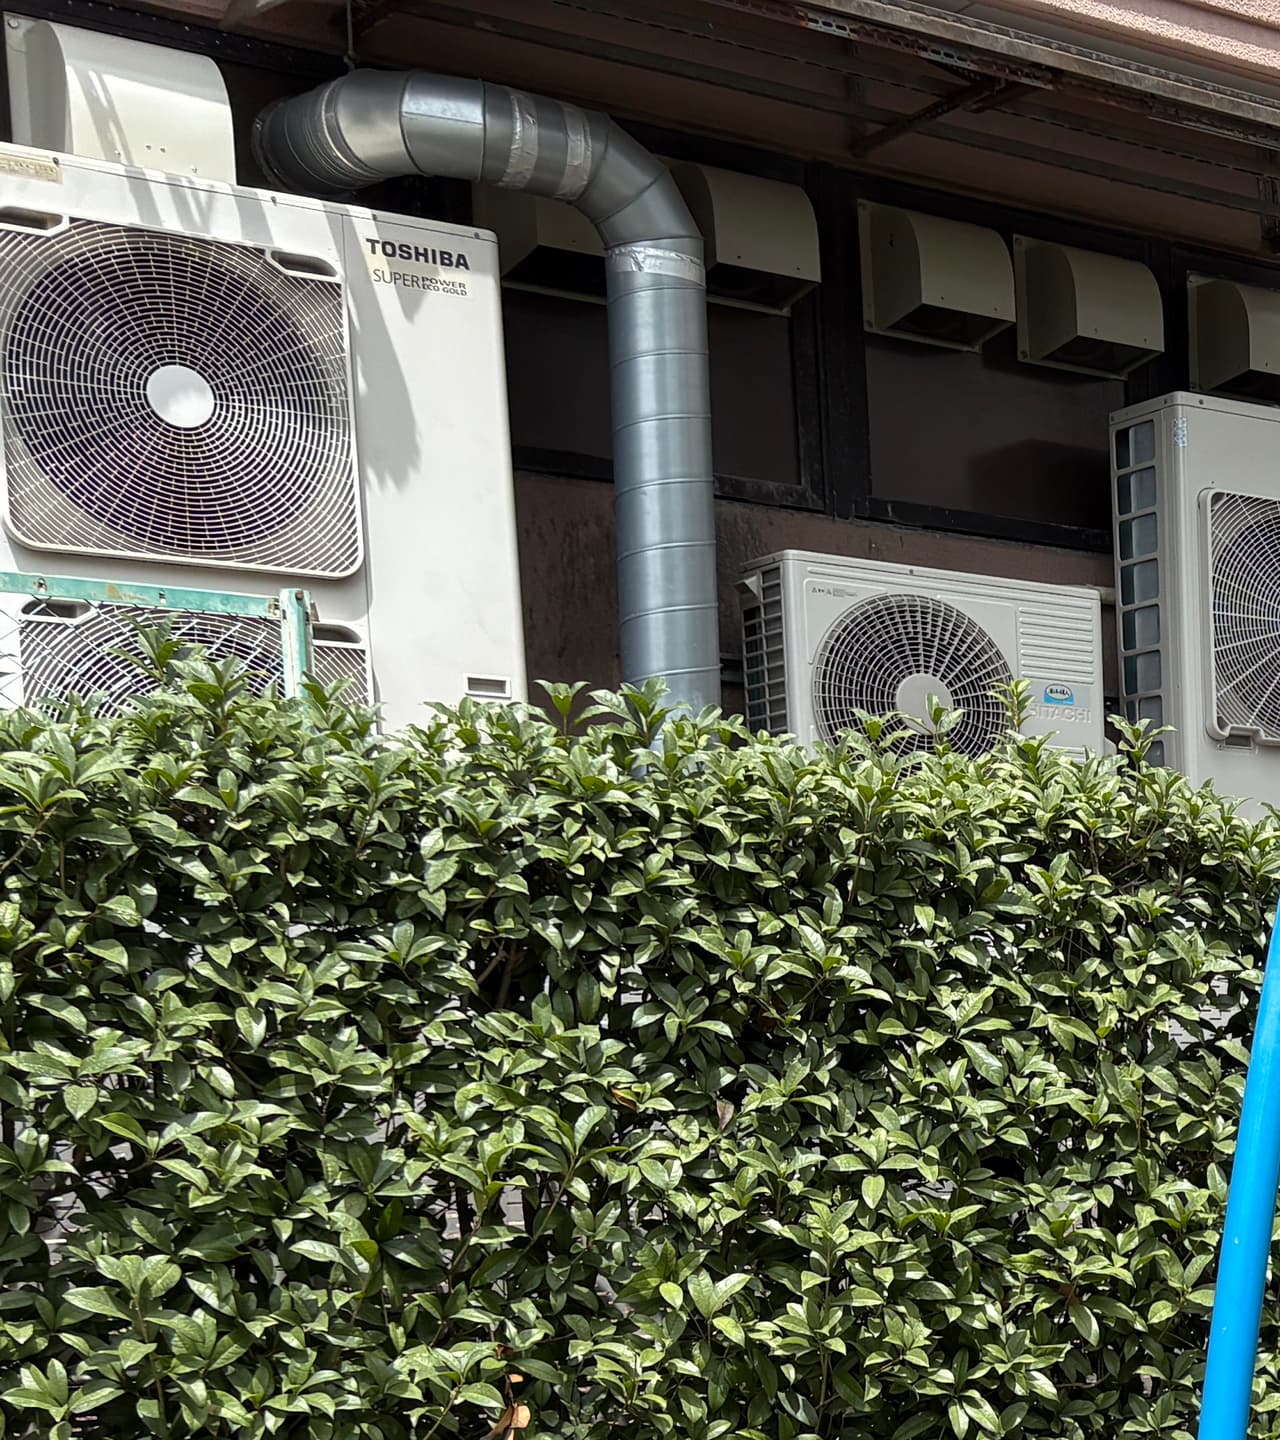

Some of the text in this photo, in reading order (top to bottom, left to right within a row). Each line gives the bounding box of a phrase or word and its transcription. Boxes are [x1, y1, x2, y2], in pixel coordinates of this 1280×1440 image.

[366, 238, 470, 270] TOSHIBA
[373, 269, 466, 289] SUPER POWER
[421, 283, 467, 296] ECO GOLD
